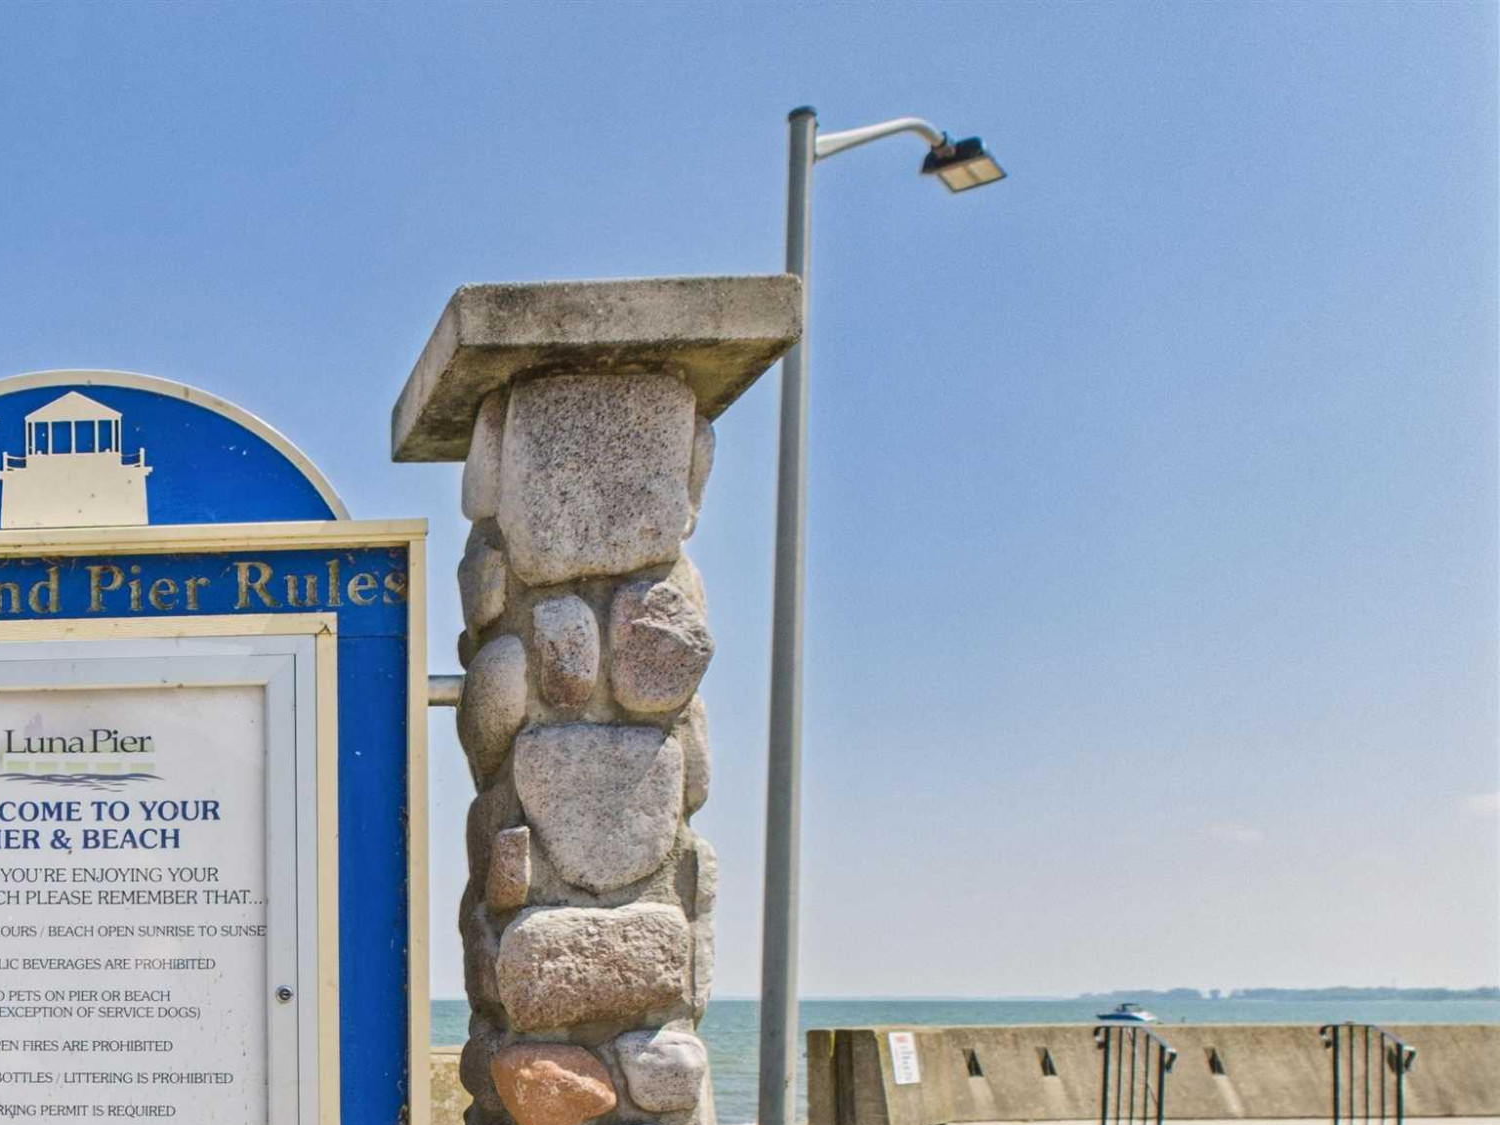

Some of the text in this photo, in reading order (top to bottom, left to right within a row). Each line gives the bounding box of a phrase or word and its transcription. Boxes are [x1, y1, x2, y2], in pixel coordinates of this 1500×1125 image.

[87, 564, 209, 613] Pier
[232, 558, 408, 609] Rules
[6, 729, 151, 753] Luna Pier
[94, 801, 129, 821] TO
[139, 800, 220, 821] YOUR
[49, 829, 72, 850] &
[82, 829, 180, 849] BEACH
[1, 868, 66, 882] YOU'RE
[73, 868, 162, 882] ENJOYING
[168, 867, 218, 882] YOUR
[26, 891, 92, 905] PLEASE
[98, 890, 197, 904] REMEMBER
[203, 890, 264, 904] THAT...
[48, 926, 94, 937] BEACH
[98, 926, 134, 937] OPEN
[138, 926, 195, 937] SUNRISE
[198, 925, 217, 937] TO
[220, 925, 267, 938] SUNSE
[23, 959, 101, 969] BEVERAGES
[105, 959, 131, 969] ARE
[135, 958, 216, 969] PROHIBITED
[9, 990, 41, 1001] PETS
[45, 991, 65, 1001] ON
[69, 990, 98, 1001] PIER
[101, 991, 121, 1001] OR
[125, 991, 170, 1001] BEACH
[0, 1007, 73, 1017] EXCEPTION
[77, 1007, 95, 1018] OF
[98, 1007, 154, 1018] SERVICE
[158, 1007, 200, 1019] DOGS)
[23, 1040, 59, 1051] FIRES
[62, 1041, 88, 1051] ARE
[92, 1040, 173, 1051] PROHIBITED
[64, 1072, 133, 1083] LITTERING
[137, 1072, 149, 1084] IS
[153, 1073, 233, 1084] PROHIBITED
[41, 1105, 89, 1116] PERMIT
[93, 1105, 104, 1116] IS
[108, 1105, 176, 1117] REQUIRED
